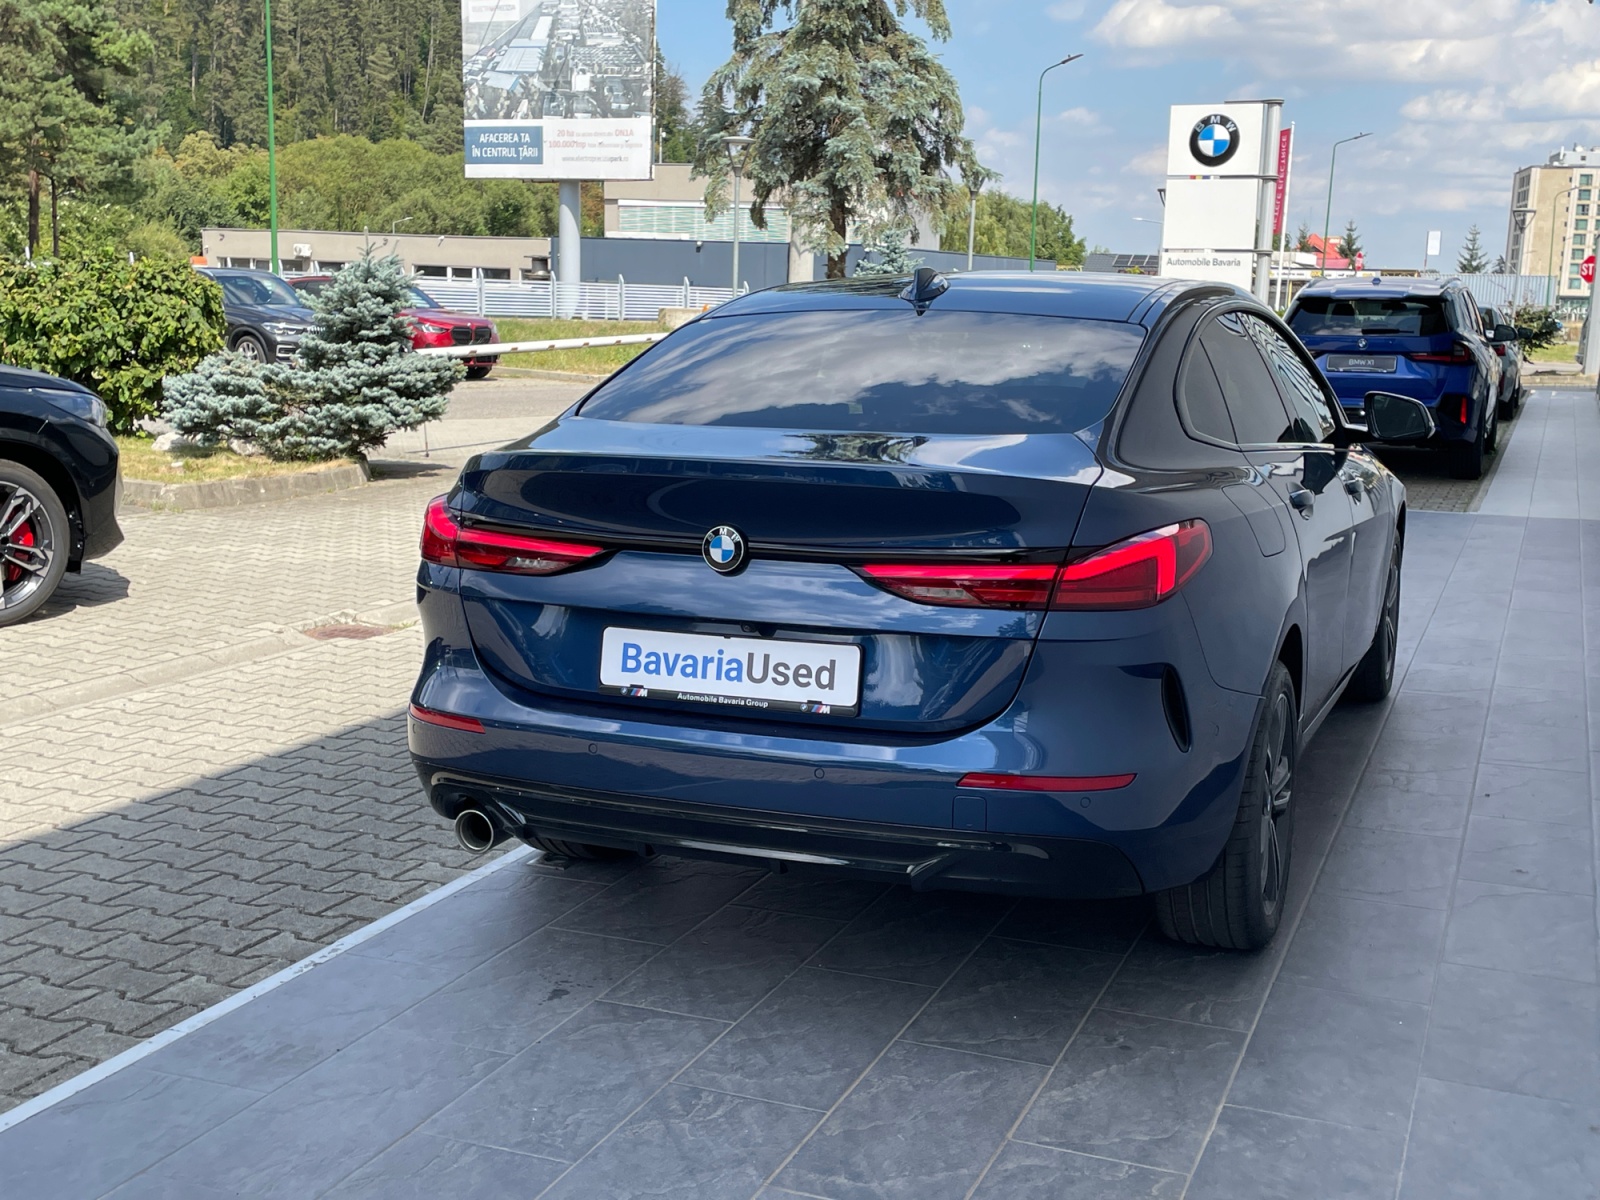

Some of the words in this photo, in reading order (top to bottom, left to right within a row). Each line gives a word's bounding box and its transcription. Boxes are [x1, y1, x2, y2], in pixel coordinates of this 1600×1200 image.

[1194, 115, 1238, 133] BMW
[479, 132, 520, 143] AFACEREA
[520, 132, 531, 143] TA
[557, 129, 566, 137] 20
[471, 144, 481, 158] ÎN
[482, 147, 517, 158] CENTRUL
[1166, 257, 1211, 267] Automobile
[1212, 257, 1241, 267] Bavaria
[1580, 263, 1595, 276] ST
[1348, 358, 1366, 366] BMW
[1366, 358, 1375, 366] X1
[706, 527, 741, 544] BMW
[621, 642, 836, 691] BavariaUsed
[677, 692, 717, 703] Automobile
[718, 696, 745, 706] Bavaria
[745, 698, 769, 708] Group
